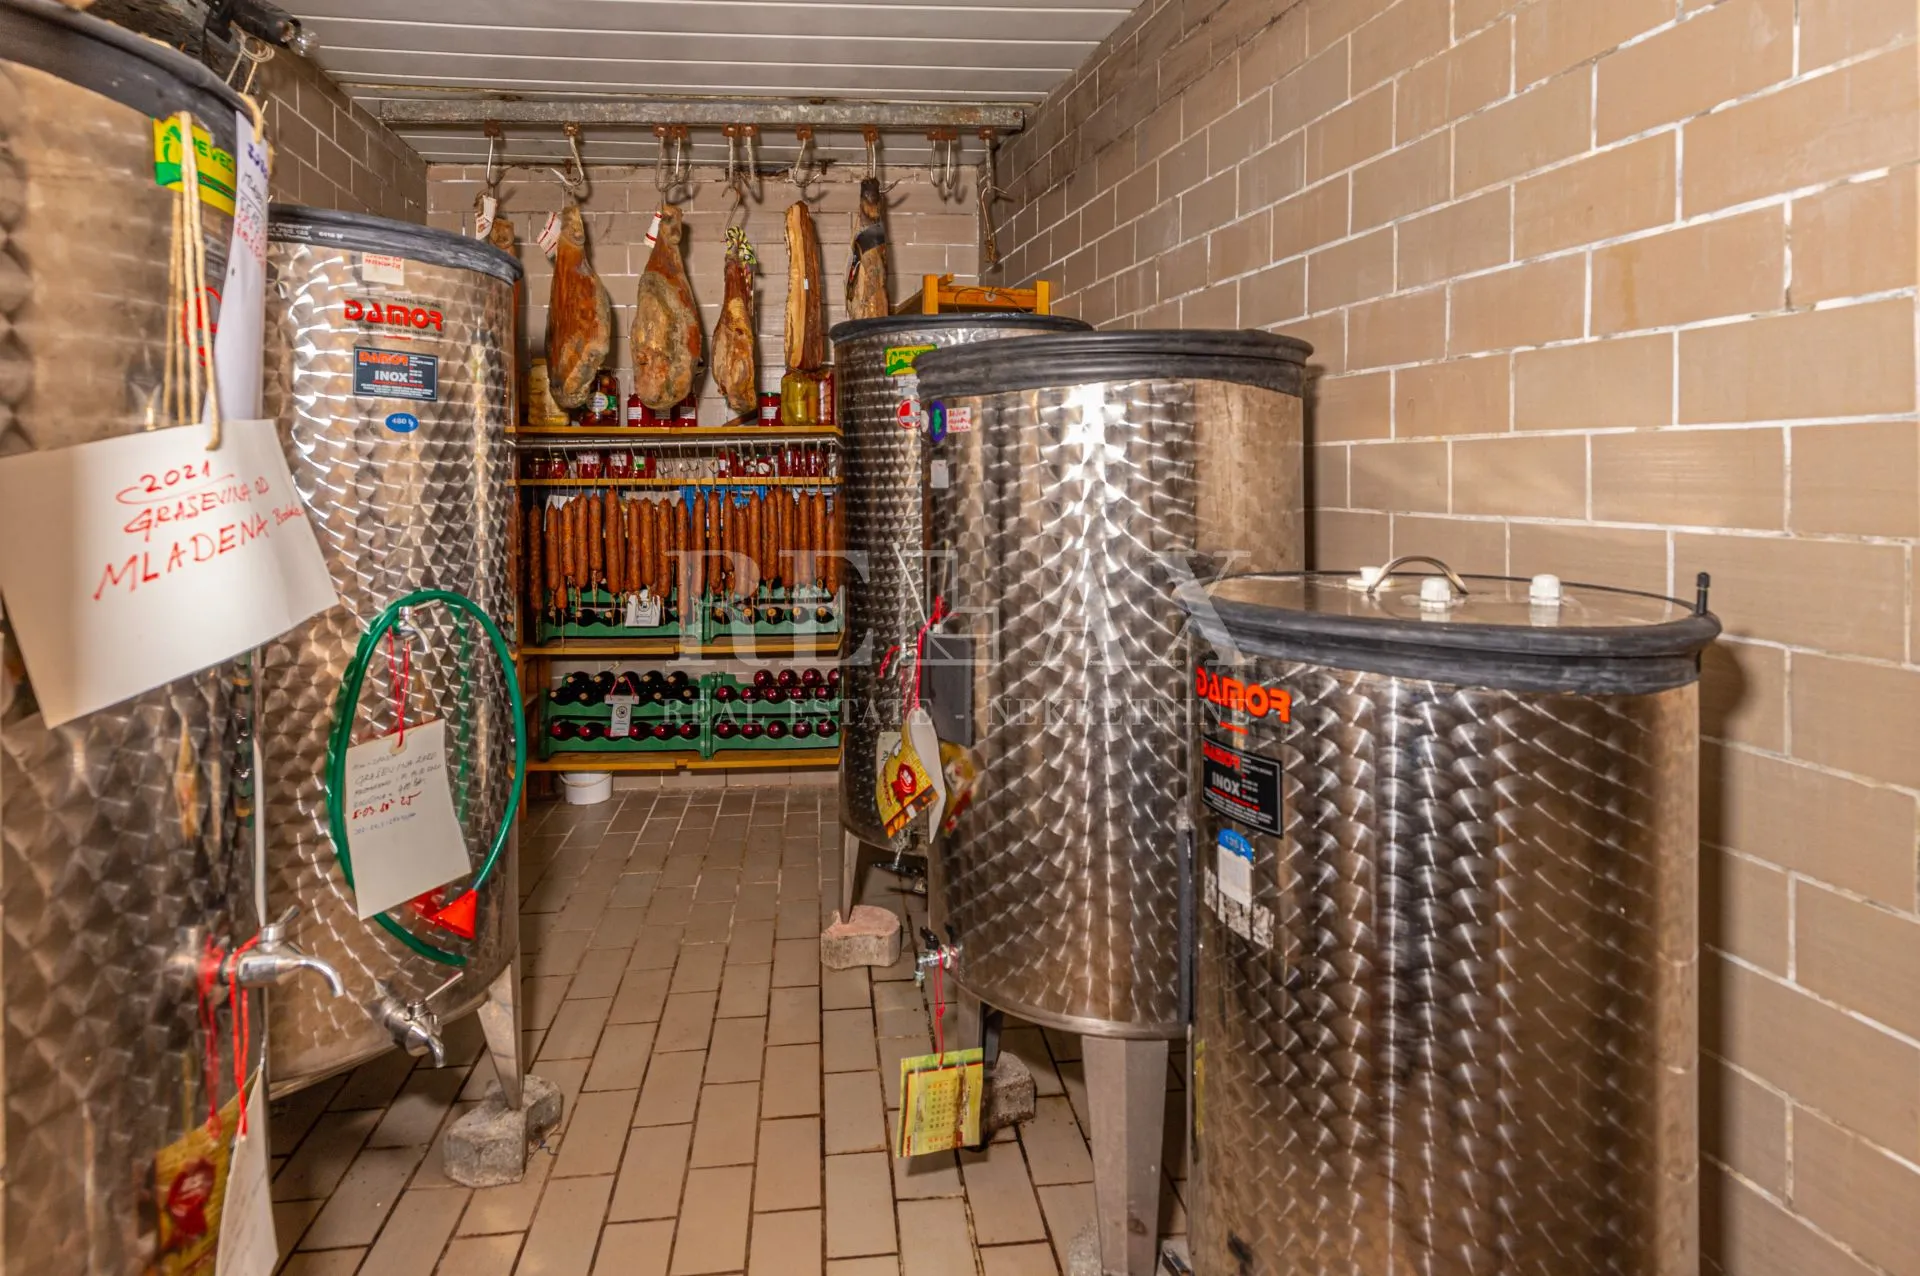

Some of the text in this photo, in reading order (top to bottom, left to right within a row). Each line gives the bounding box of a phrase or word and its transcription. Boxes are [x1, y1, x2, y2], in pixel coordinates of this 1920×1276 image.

[343, 299, 443, 331] DAMOR
[374, 369, 409, 383] INOX
[139, 459, 211, 493] 2021
[93, 512, 269, 601] MLADENA
[1207, 771, 1241, 797] INOX
